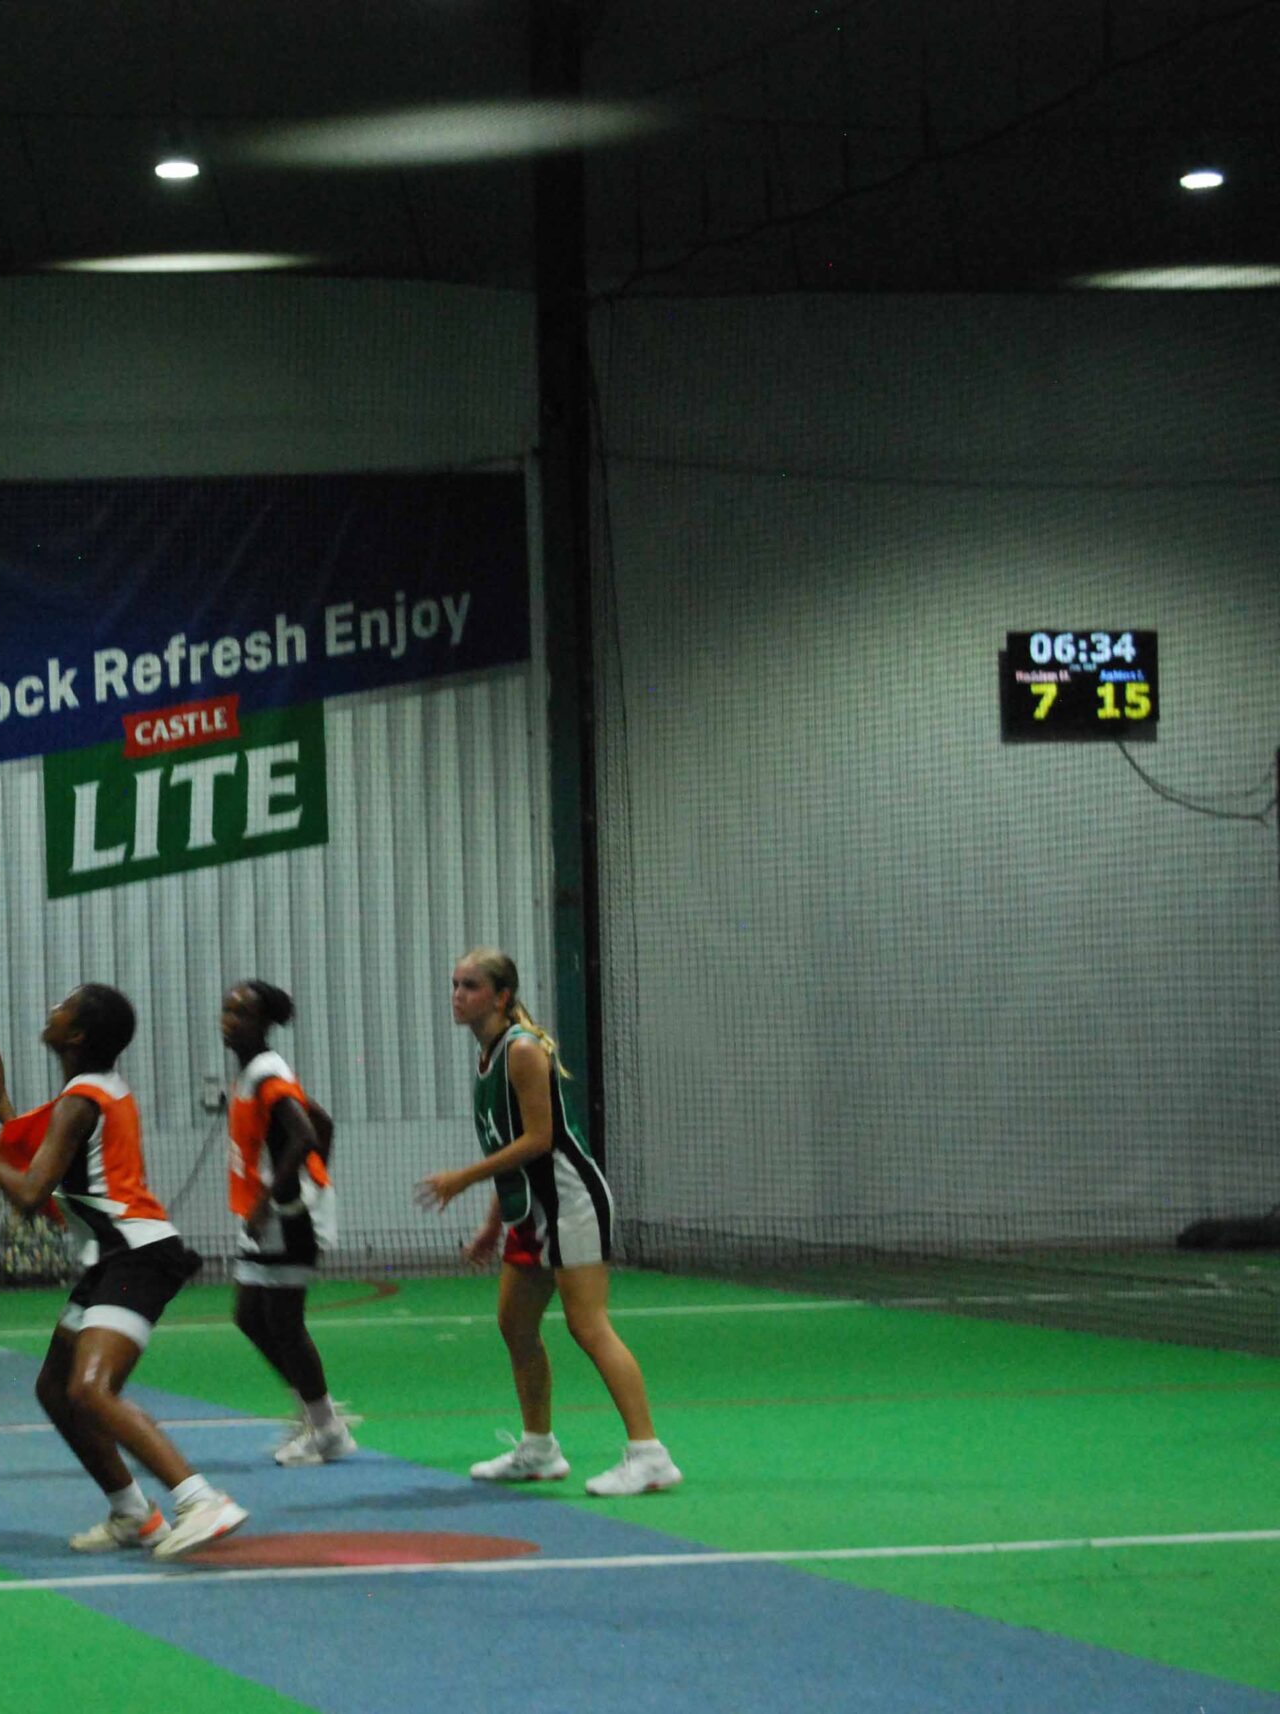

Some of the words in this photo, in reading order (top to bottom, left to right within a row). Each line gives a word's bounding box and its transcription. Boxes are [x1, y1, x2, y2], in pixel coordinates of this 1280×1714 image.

[93, 612, 308, 704] Refresh
[324, 588, 472, 660] Enjoy
[1029, 632, 1136, 665] 06:34
[1029, 683, 1058, 721] 7
[1096, 683, 1151, 720] 15
[133, 703, 230, 747] CASTLE
[67, 739, 305, 876] LITE
